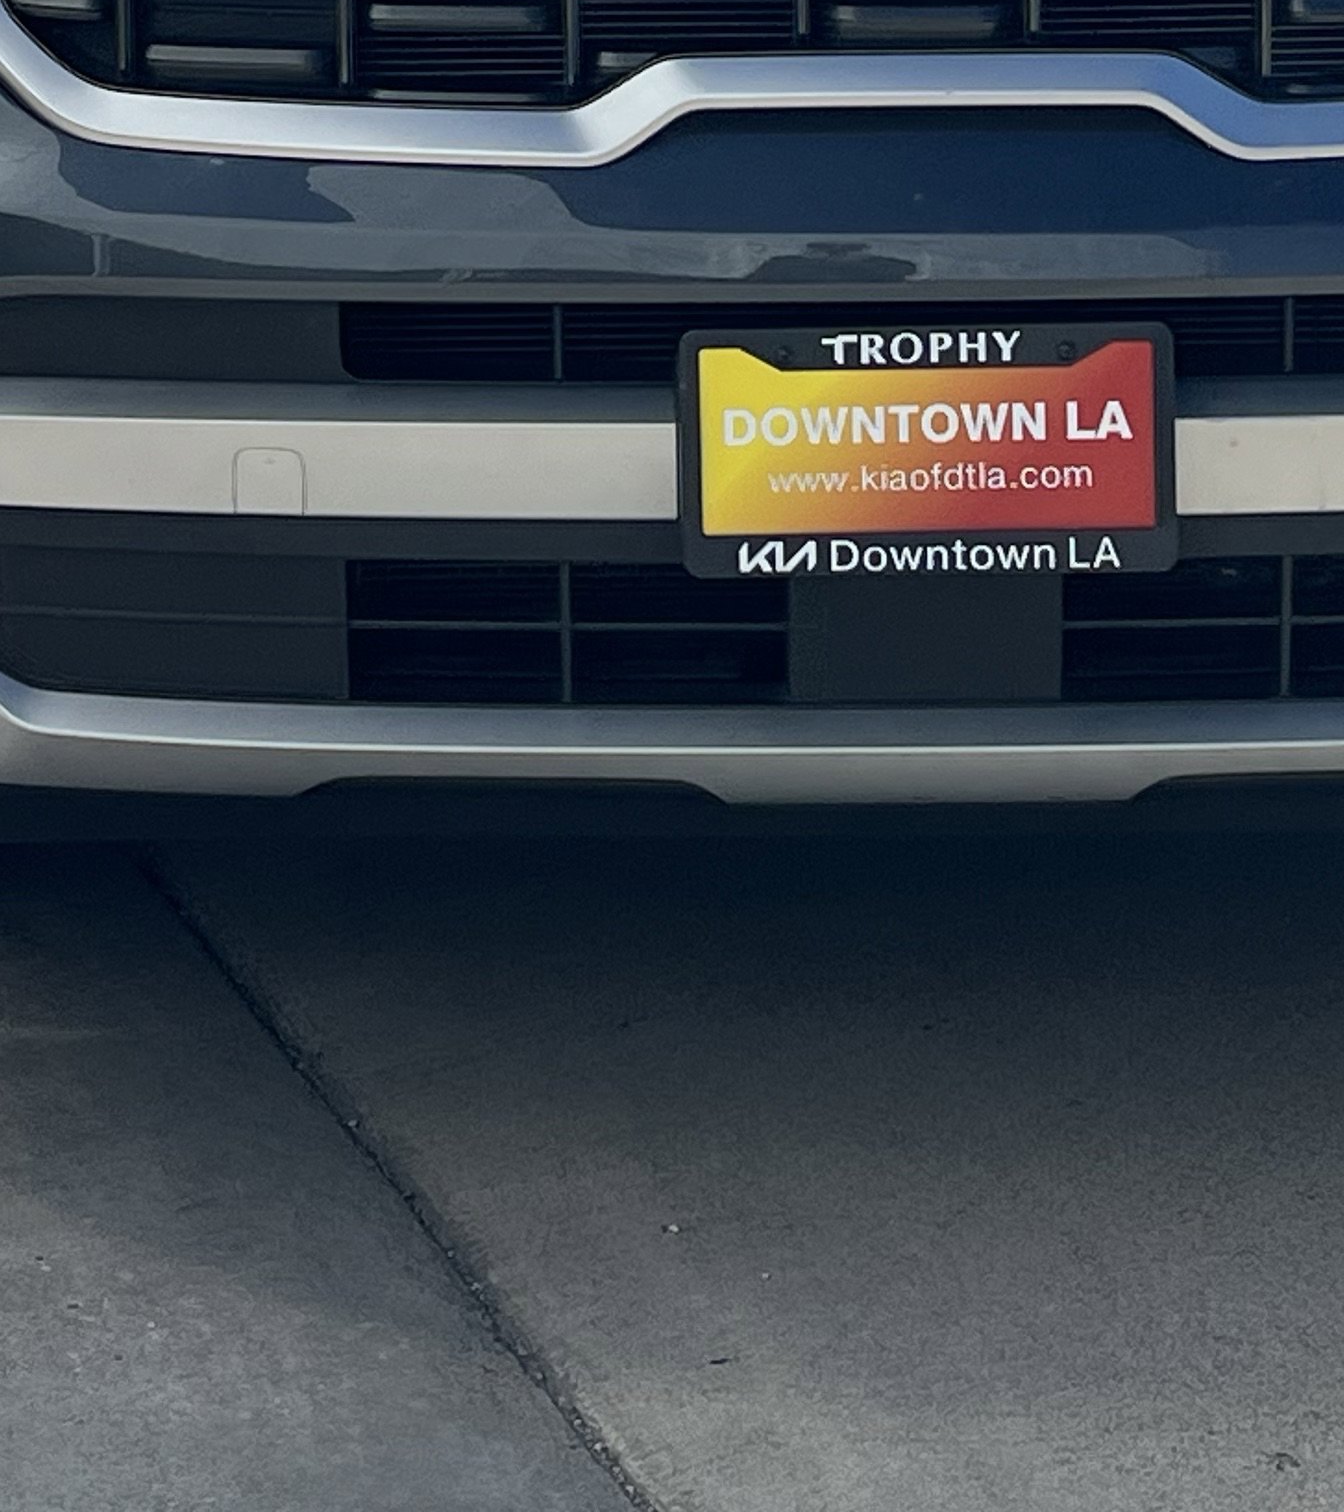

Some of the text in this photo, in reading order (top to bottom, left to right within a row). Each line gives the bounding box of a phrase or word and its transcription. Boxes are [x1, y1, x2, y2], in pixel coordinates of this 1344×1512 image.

[821, 330, 1022, 365] TROPHY
[721, 399, 1134, 447] DOWNTOWN LA
[767, 461, 1094, 493] www.kiaofdtla.com
[738, 535, 1122, 574] KIA Downtown LA
